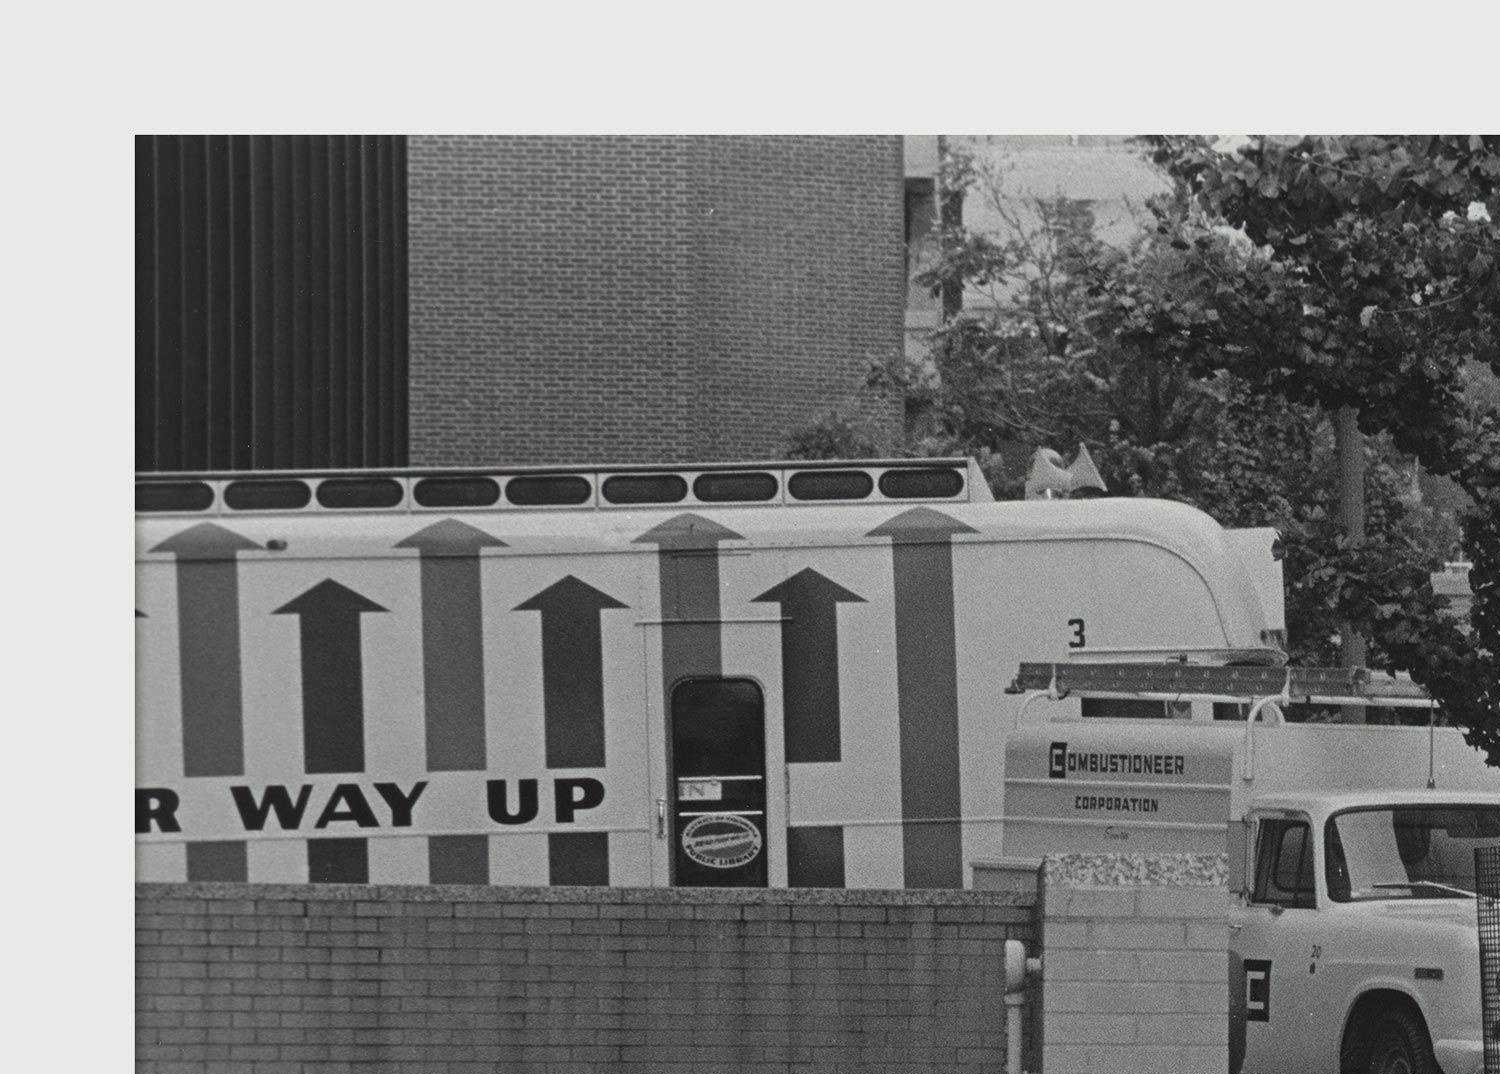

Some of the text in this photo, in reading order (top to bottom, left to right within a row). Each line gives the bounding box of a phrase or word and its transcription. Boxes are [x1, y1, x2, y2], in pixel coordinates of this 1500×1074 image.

[1068, 618, 1086, 648] 3
[1048, 741, 1185, 779] COMBUSTIONEER
[229, 780, 429, 831] WAY
[486, 776, 606, 825] UP
[1075, 795, 1159, 813] CORPORATION
